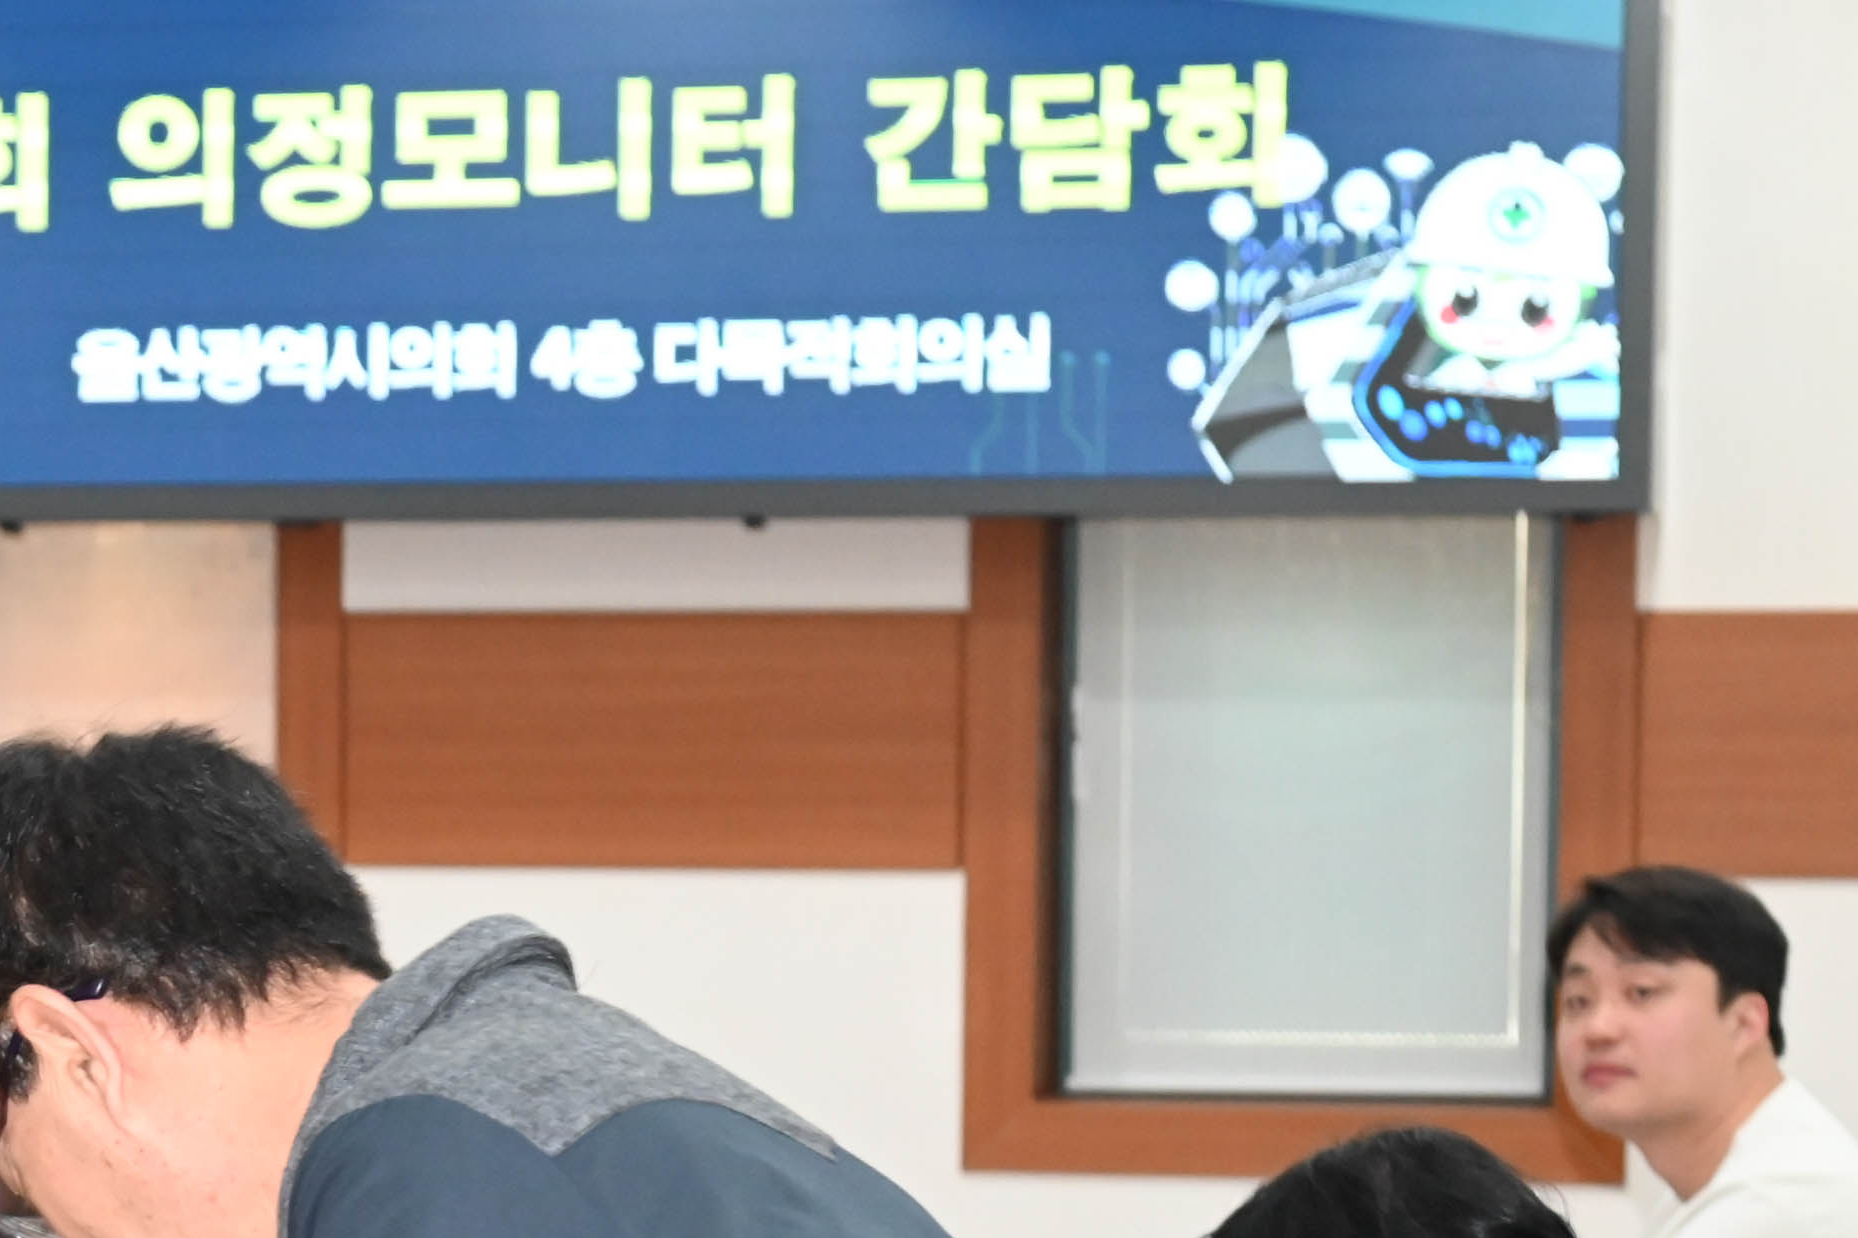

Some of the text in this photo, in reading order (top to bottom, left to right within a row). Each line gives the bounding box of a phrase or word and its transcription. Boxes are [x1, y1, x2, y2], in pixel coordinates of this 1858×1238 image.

[109, 73, 795, 227] 의정모니터
[864, 61, 1289, 212] 간담회
[71, 312, 1051, 402] 울산광역시의회 4층 다목적회의실
